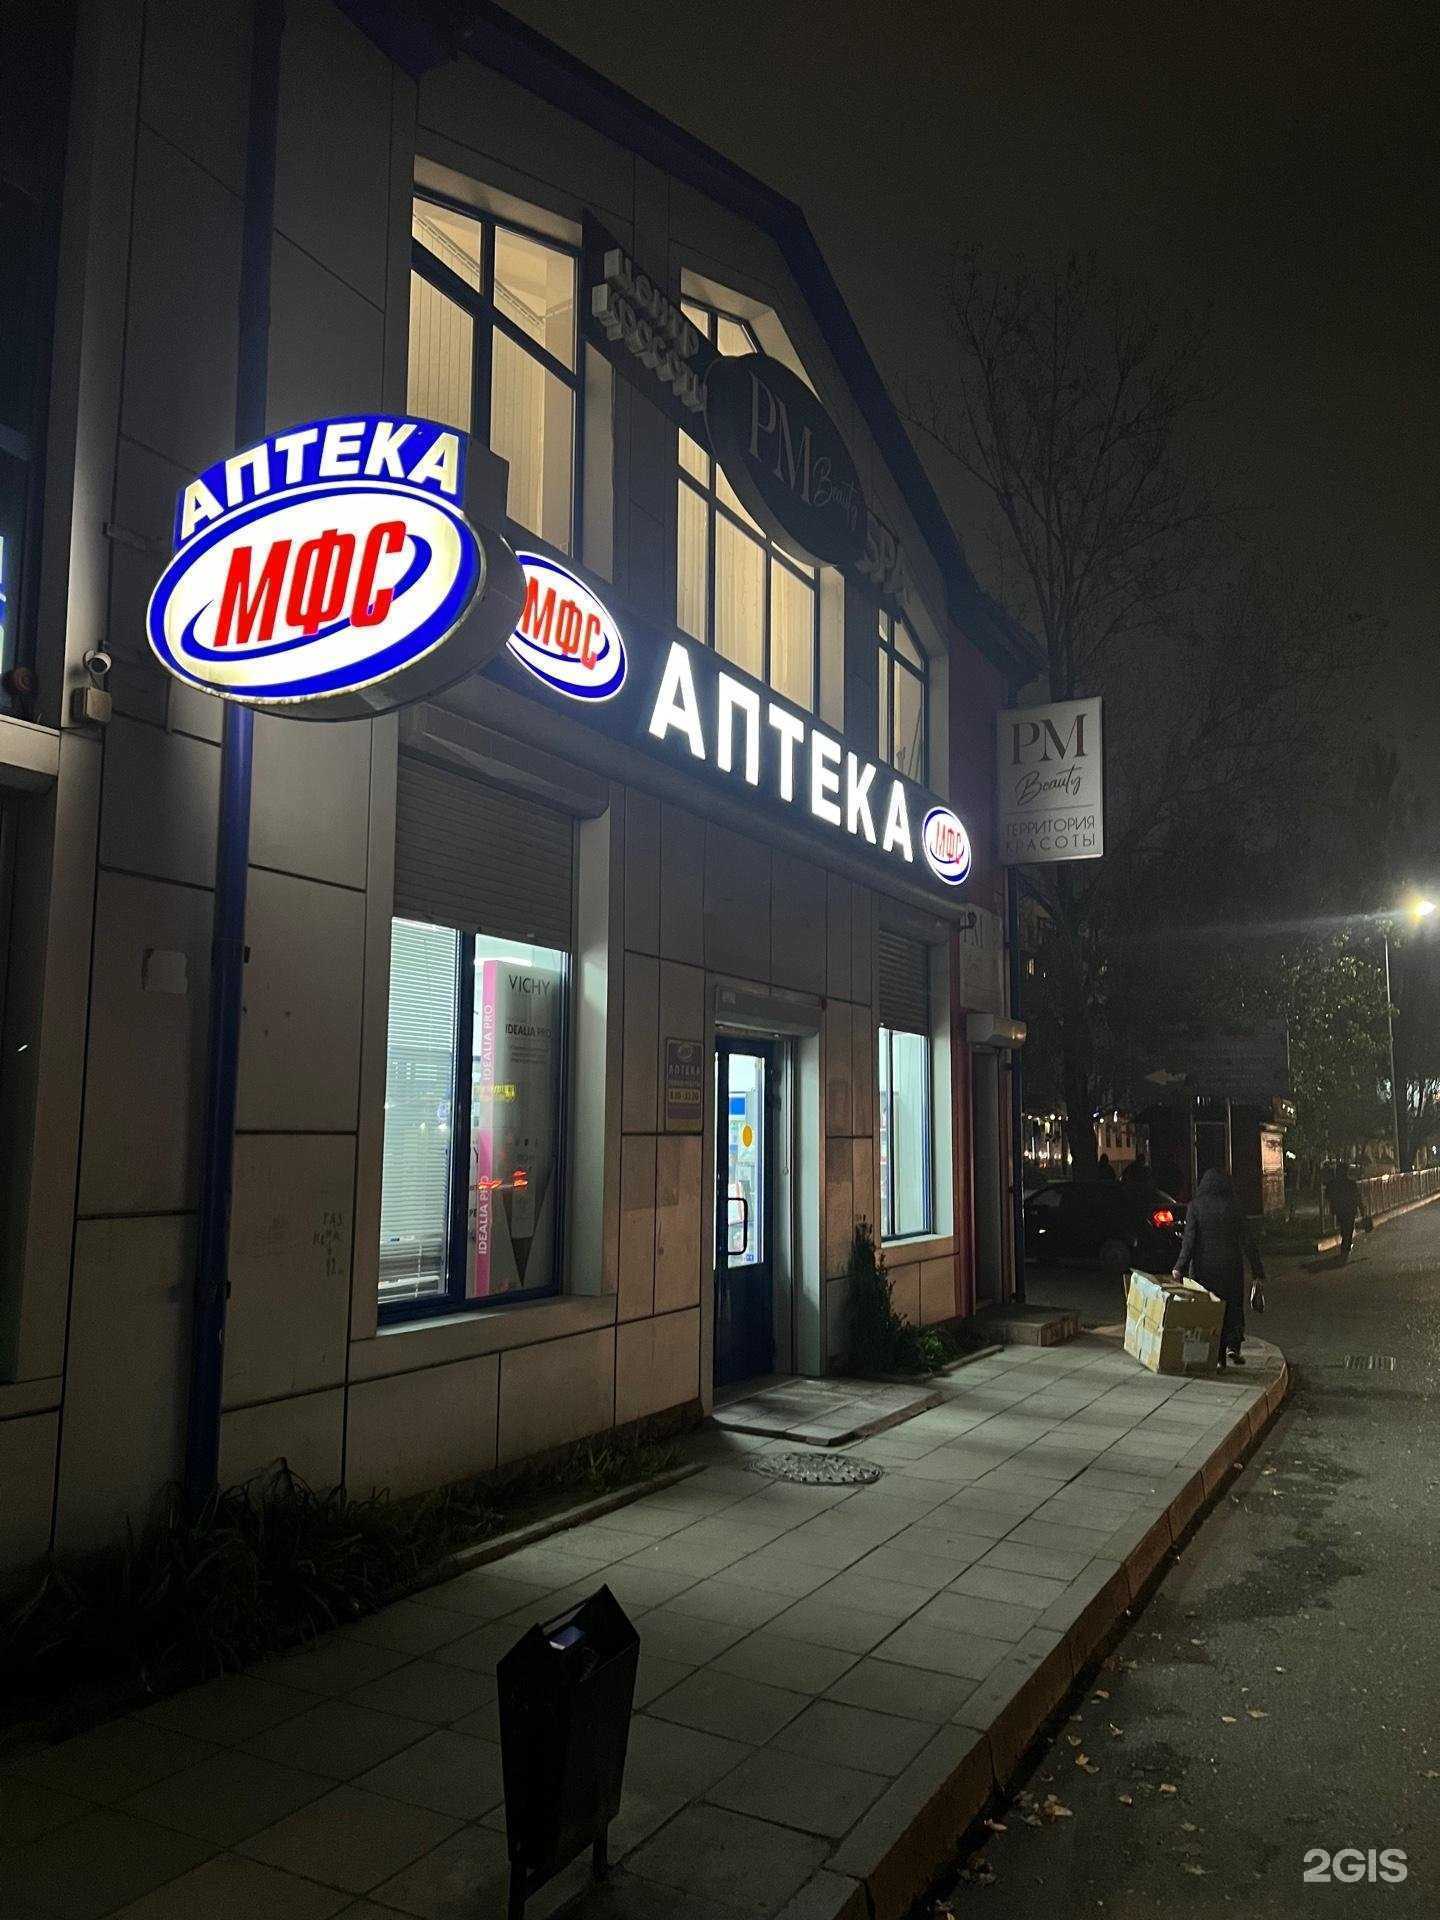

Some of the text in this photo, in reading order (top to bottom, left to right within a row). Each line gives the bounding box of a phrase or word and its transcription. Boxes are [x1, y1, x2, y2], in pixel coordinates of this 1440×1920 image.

[748, 370, 813, 506] PM
[180, 421, 461, 541] АПТЕКА
[213, 520, 407, 648] МФС
[521, 575, 602, 671] МФС
[648, 641, 914, 864] АПТЕКА
[1011, 714, 1087, 766] PM
[1015, 764, 1082, 806] Beauty
[1007, 815, 1096, 837] ТЕРРИТОРИЯ
[508, 974, 551, 996] VICHY
[482, 1004, 494, 1081] IDEALIA PRO
[505, 1022, 536, 1038] IDEALIA
[478, 1203, 488, 1255] IDEALIA
